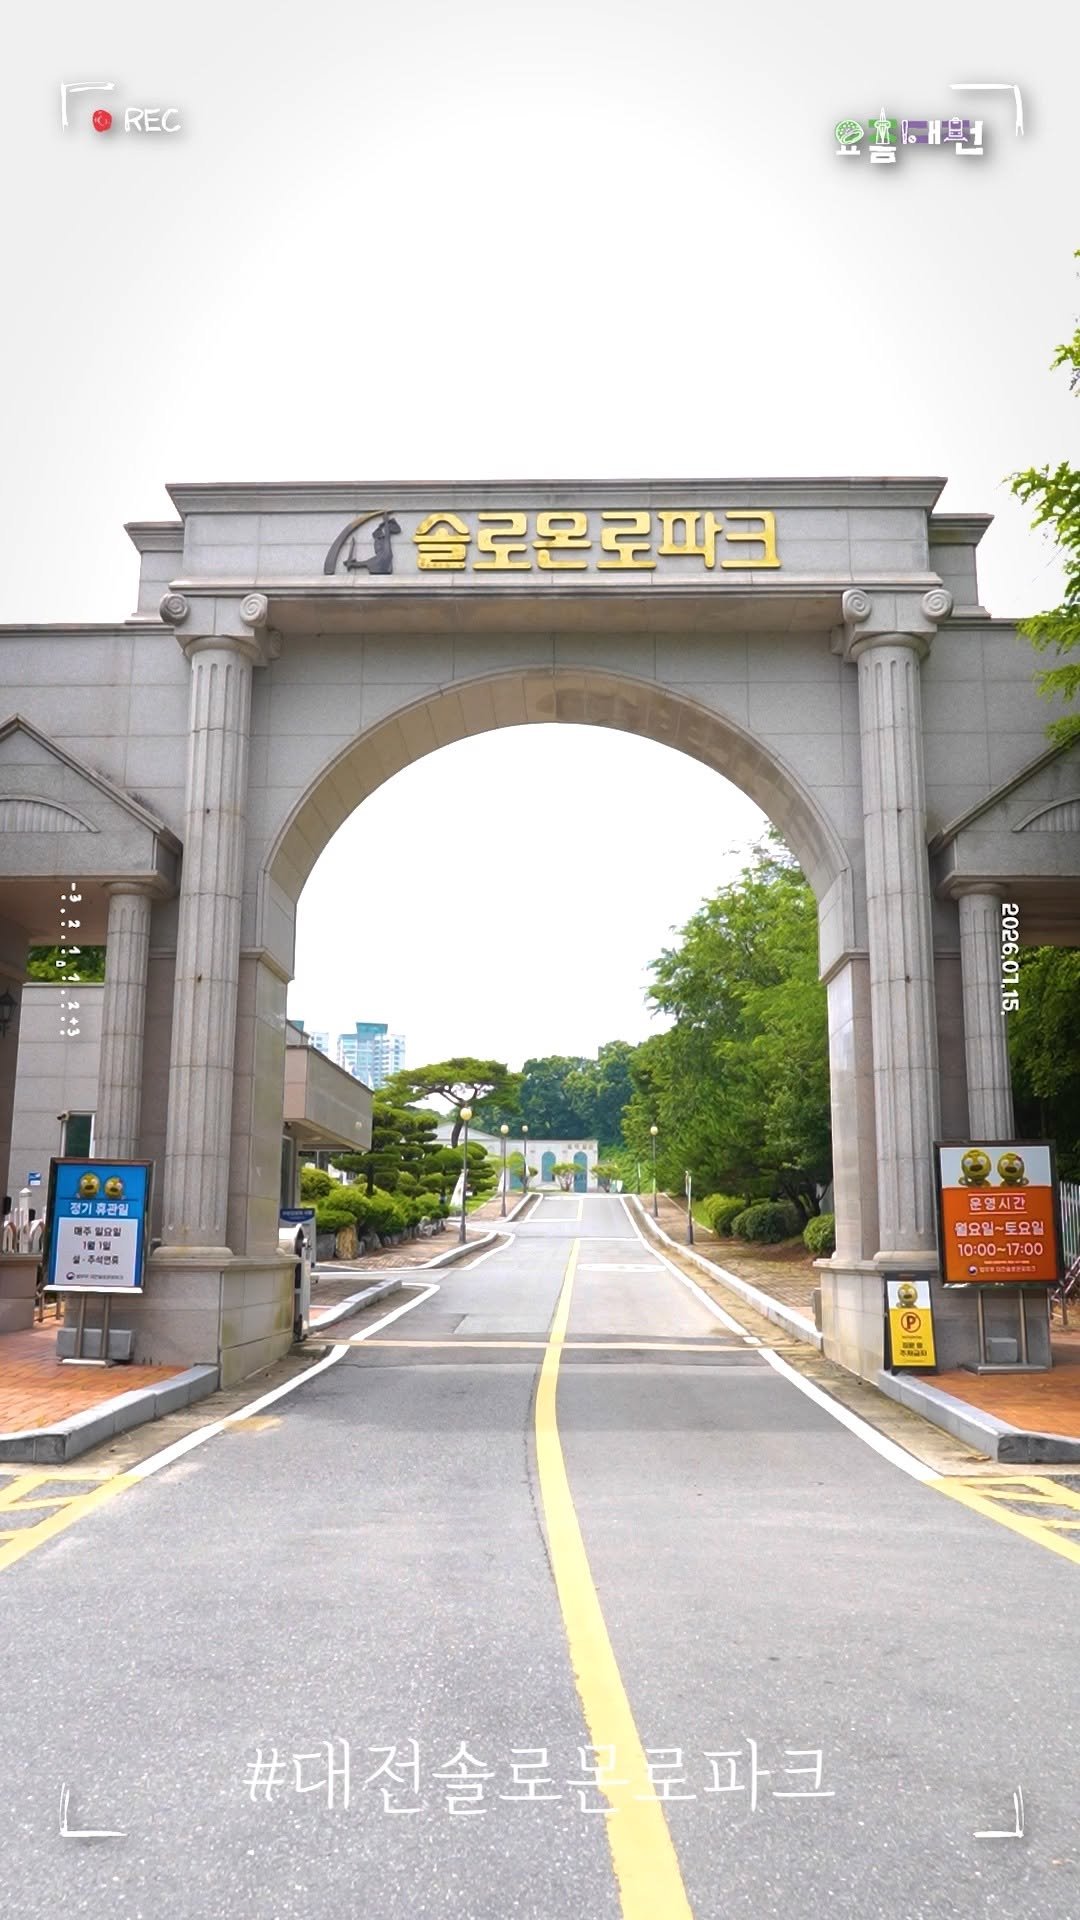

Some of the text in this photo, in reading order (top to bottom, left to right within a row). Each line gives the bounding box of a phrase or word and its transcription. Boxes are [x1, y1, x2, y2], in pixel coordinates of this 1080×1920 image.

[412, 511, 782, 571] 솔로몬로파크
[70, 1202, 129, 1216] 정기 휴관일
[970, 1196, 1026, 1211] 운영시간
[74, 1226, 122, 1237] 매주 일요일
[955, 1220, 1045, 1237] 월요일~토요일
[98, 1241, 111, 1251] 1일
[957, 1242, 1044, 1257] 10:00~17:00
